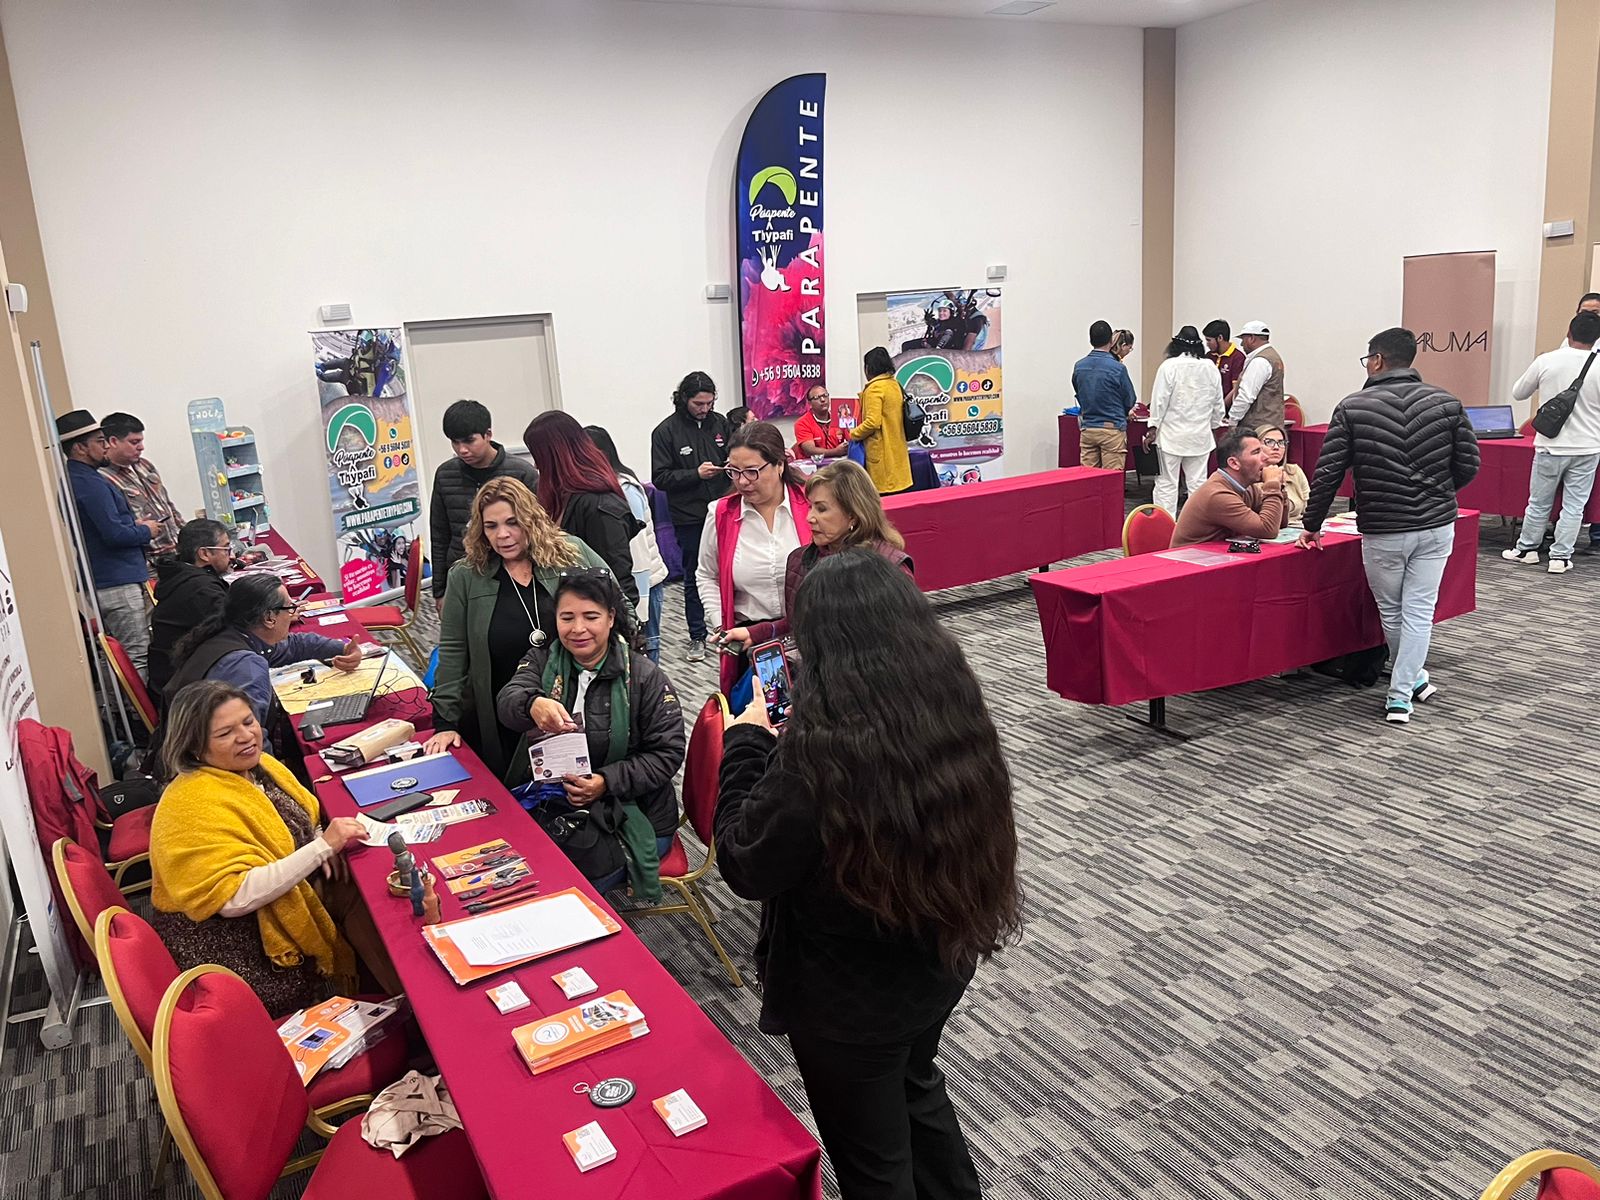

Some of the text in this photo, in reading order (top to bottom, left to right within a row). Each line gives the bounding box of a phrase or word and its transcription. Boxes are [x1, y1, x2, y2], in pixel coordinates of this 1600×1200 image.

[799, 99, 821, 355] PARAPENTE
[752, 230, 793, 243] Thypafi
[760, 364, 821, 381] +56 9 5604 5838
[925, 411, 947, 423] pafi
[943, 424, 956, 436] +56
[339, 467, 375, 484] Thypafi
